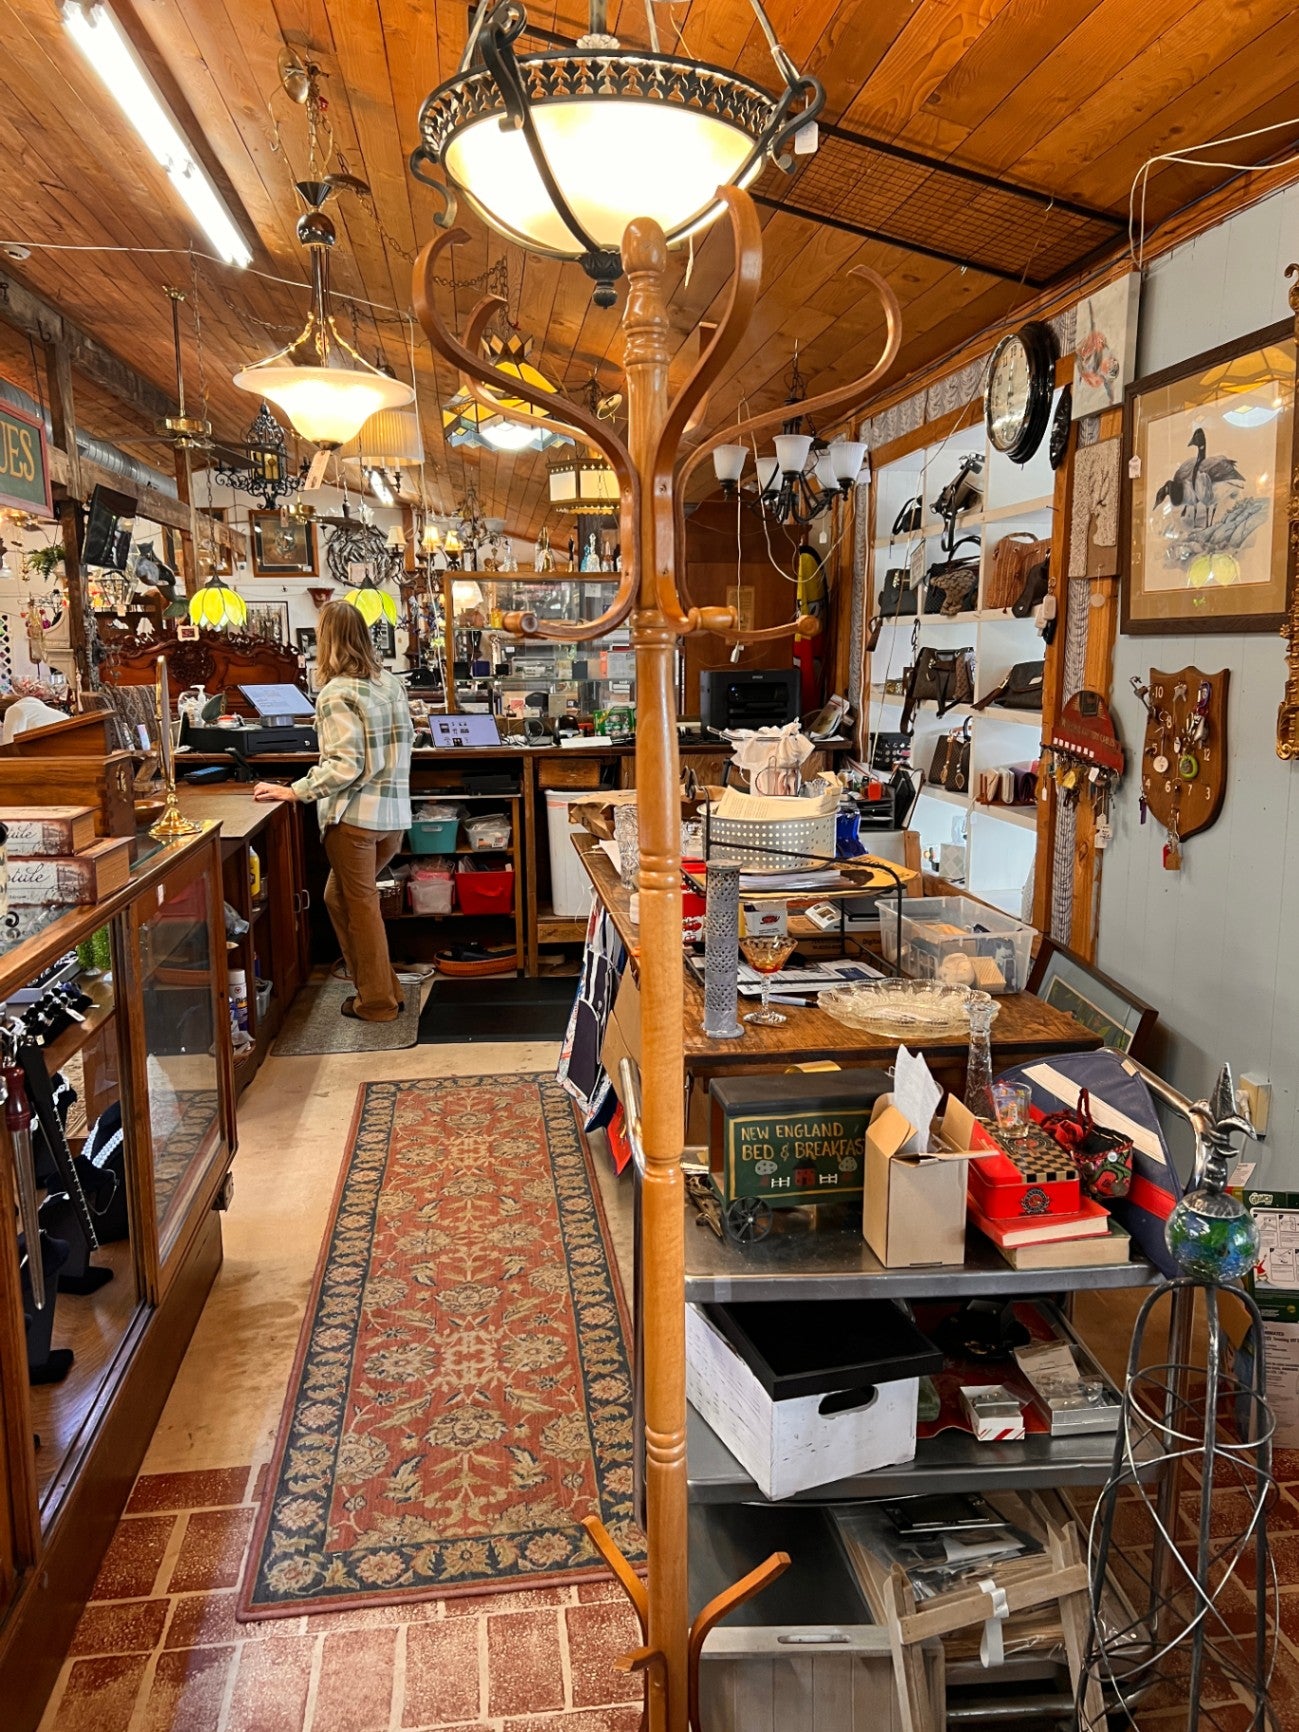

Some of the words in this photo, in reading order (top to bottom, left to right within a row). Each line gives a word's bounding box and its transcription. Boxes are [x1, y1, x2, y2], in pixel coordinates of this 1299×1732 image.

[1155, 686, 1164, 698] 10
[1166, 715, 1172, 729] 8
[1203, 748, 1211, 761] 12
[1145, 778, 1151, 789] 4
[1165, 780, 1171, 793] 6
[1188, 784, 1193, 796] 7
[1205, 787, 1211, 800] 3
[741, 1126, 770, 1141] NEW
[775, 1122, 844, 1139] ENGLAND
[741, 1144, 775, 1161] BED
[780, 1144, 790, 1162] &
